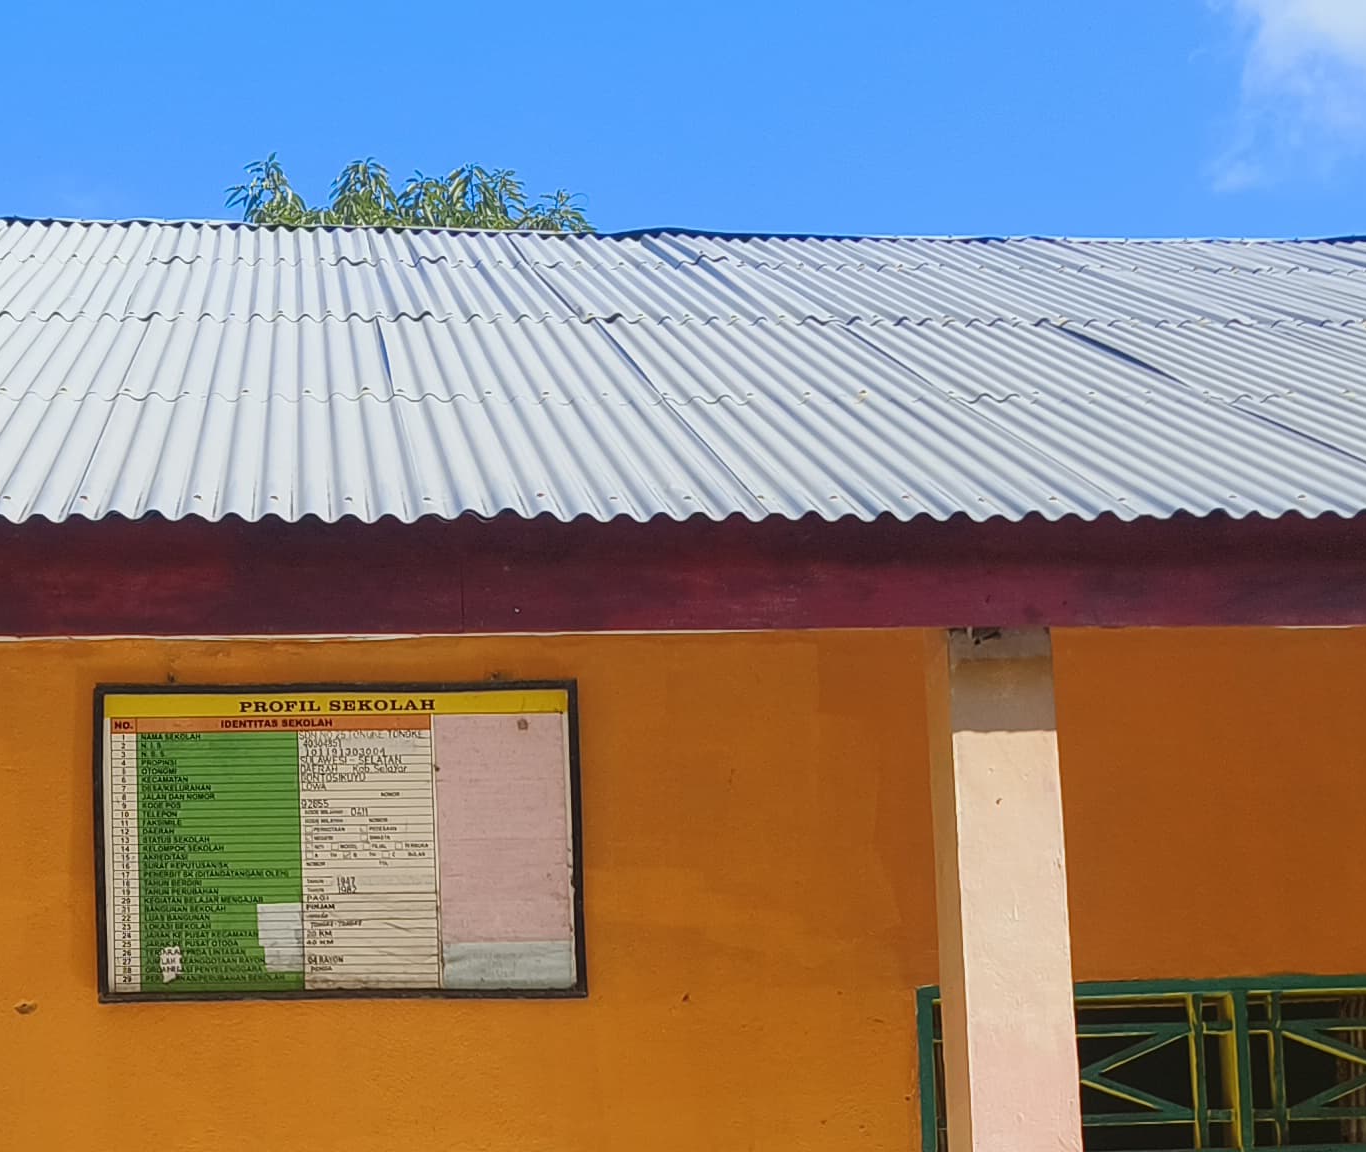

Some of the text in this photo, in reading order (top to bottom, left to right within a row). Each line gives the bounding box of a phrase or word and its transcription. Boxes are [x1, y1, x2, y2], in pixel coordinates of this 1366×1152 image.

[239, 699, 435, 713] PROFIL SEKOLAH
[114, 721, 133, 730] NO.
[220, 719, 333, 729] IDENTITAS SEKOLAH
[141, 767, 177, 775] OTONOMI
[145, 922, 212, 930] LOKASI SEKOLAH
